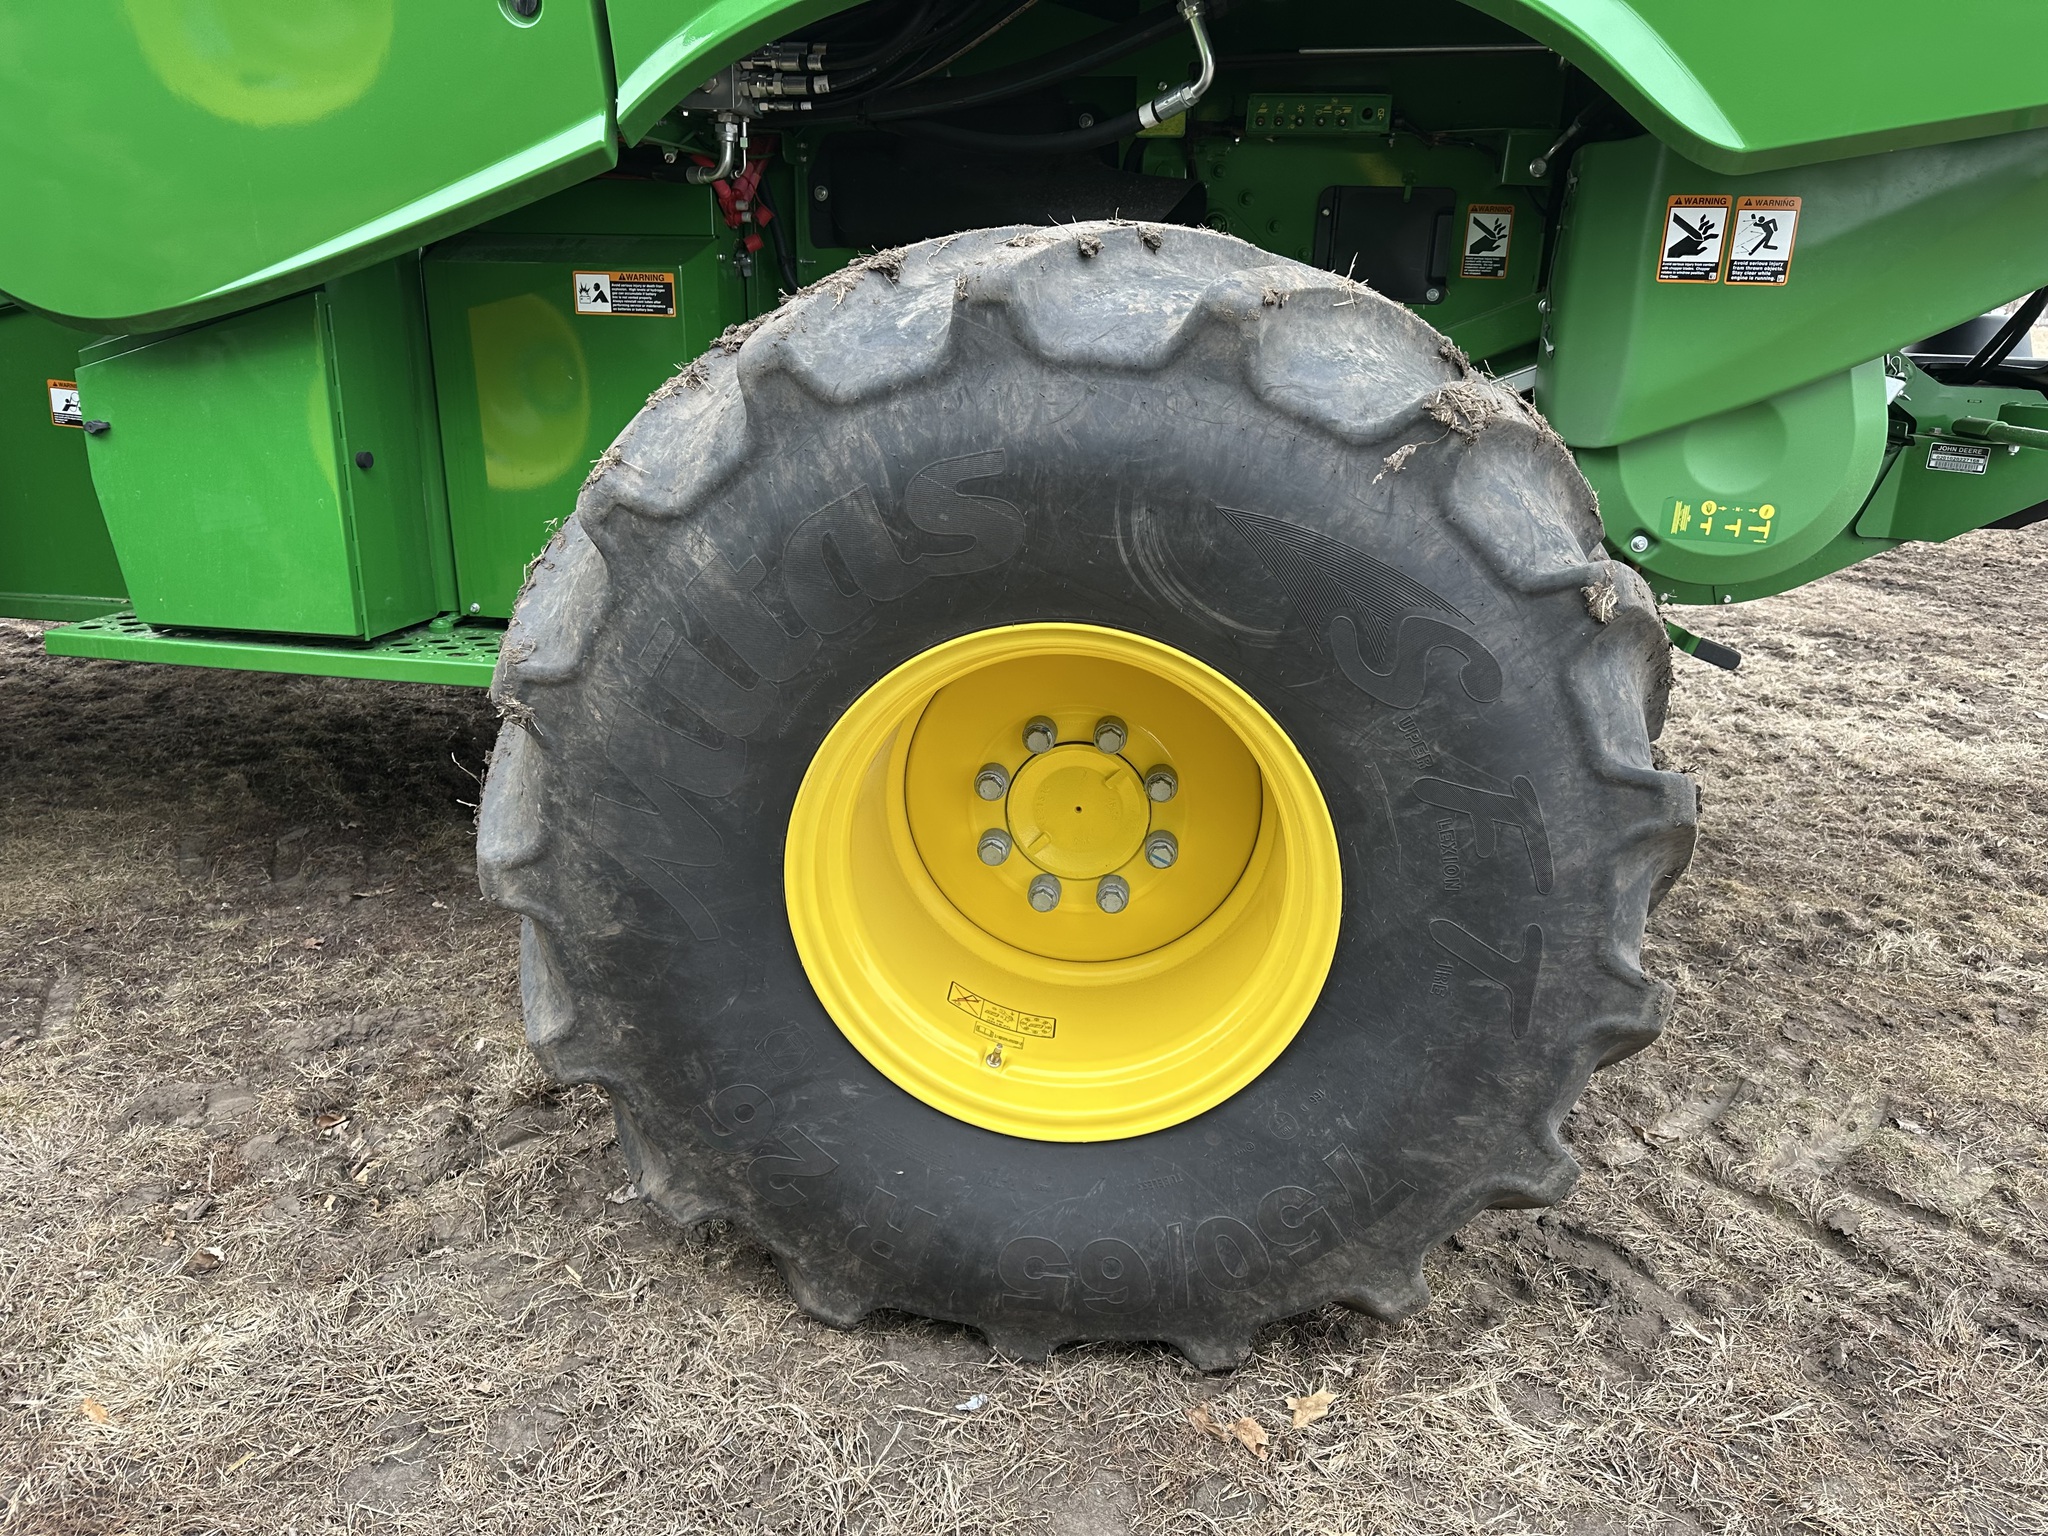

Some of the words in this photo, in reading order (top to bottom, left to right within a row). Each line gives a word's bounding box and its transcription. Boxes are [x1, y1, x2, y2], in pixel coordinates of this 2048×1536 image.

[592, 447, 1027, 942] Mitas
[690, 1082, 839, 1208] 26
[1309, 1088, 1325, 1107] 166
[844, 1184, 939, 1279] R
[997, 1143, 1419, 1315] 750/65
[1136, 1174, 1184, 1191] TUBELESS
